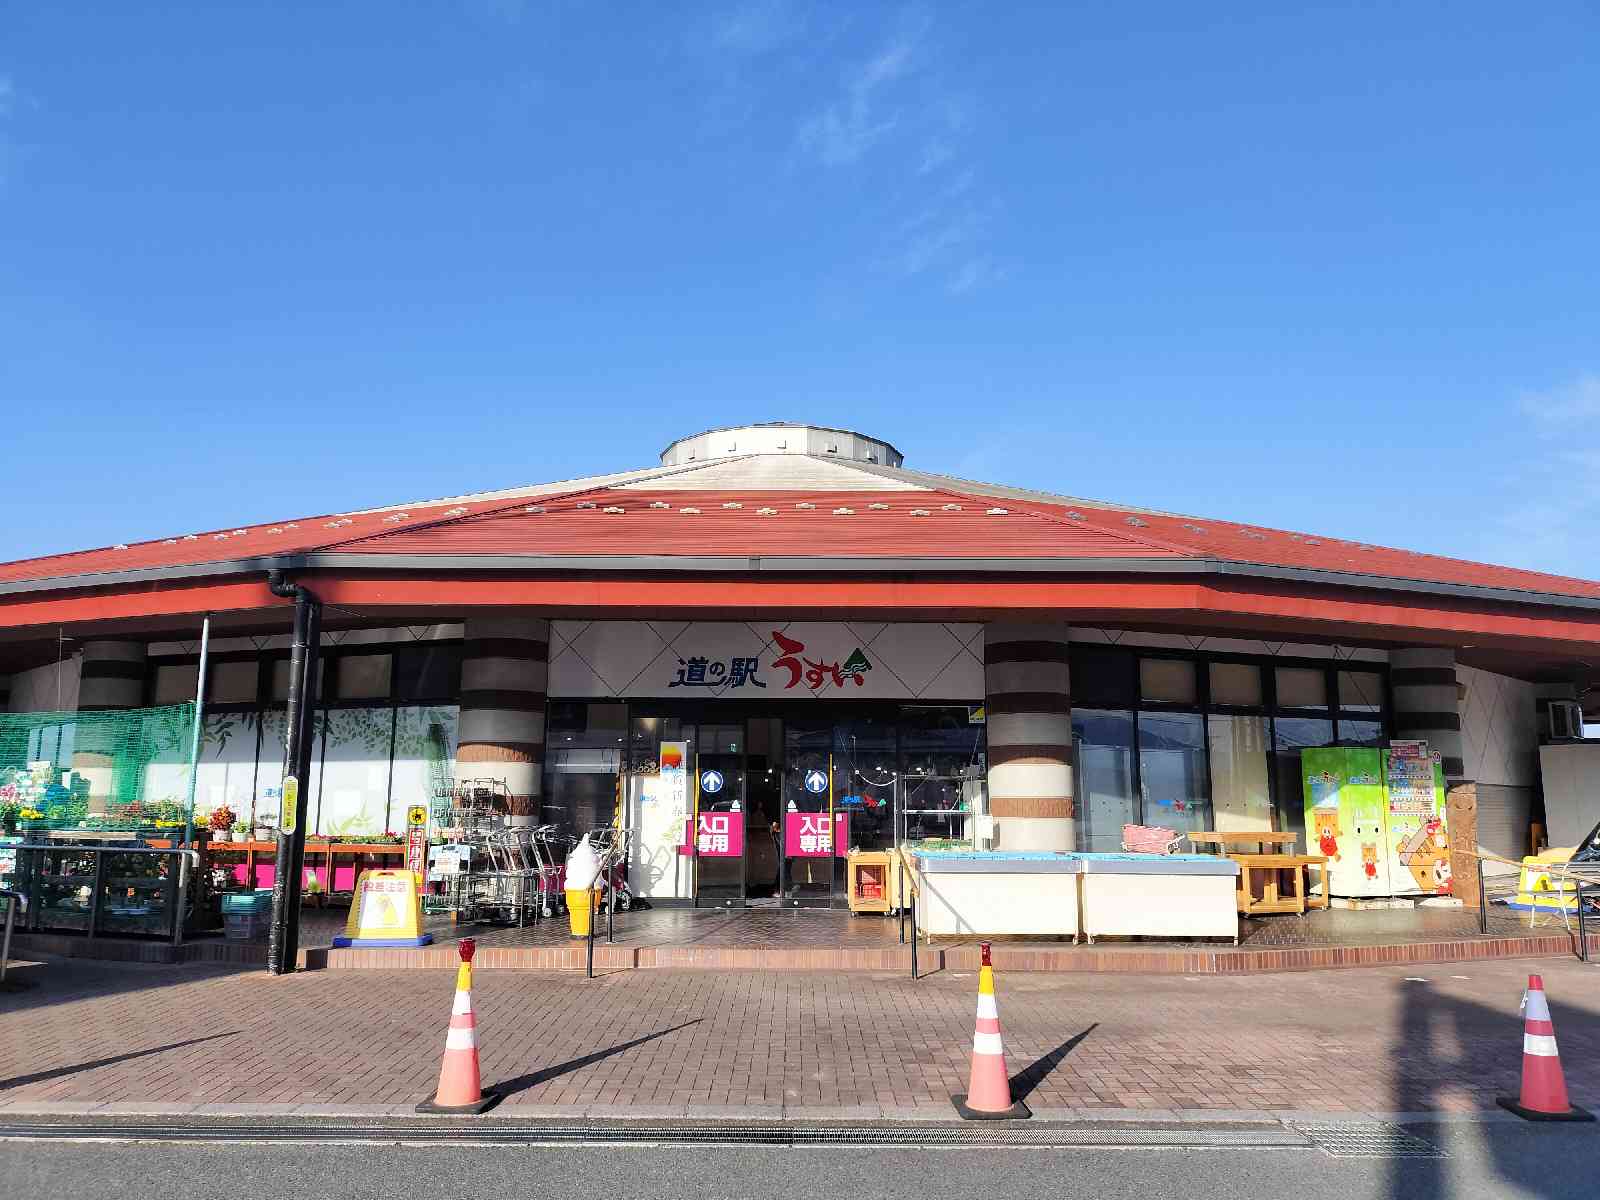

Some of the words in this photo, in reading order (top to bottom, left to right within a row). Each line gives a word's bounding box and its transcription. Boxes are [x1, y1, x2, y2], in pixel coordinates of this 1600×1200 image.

[668, 655, 767, 689] 道の駅
[699, 816, 729, 834] 入口
[800, 816, 832, 834] 入口
[699, 834, 729, 853] 専用
[800, 834, 832, 853] 専用
